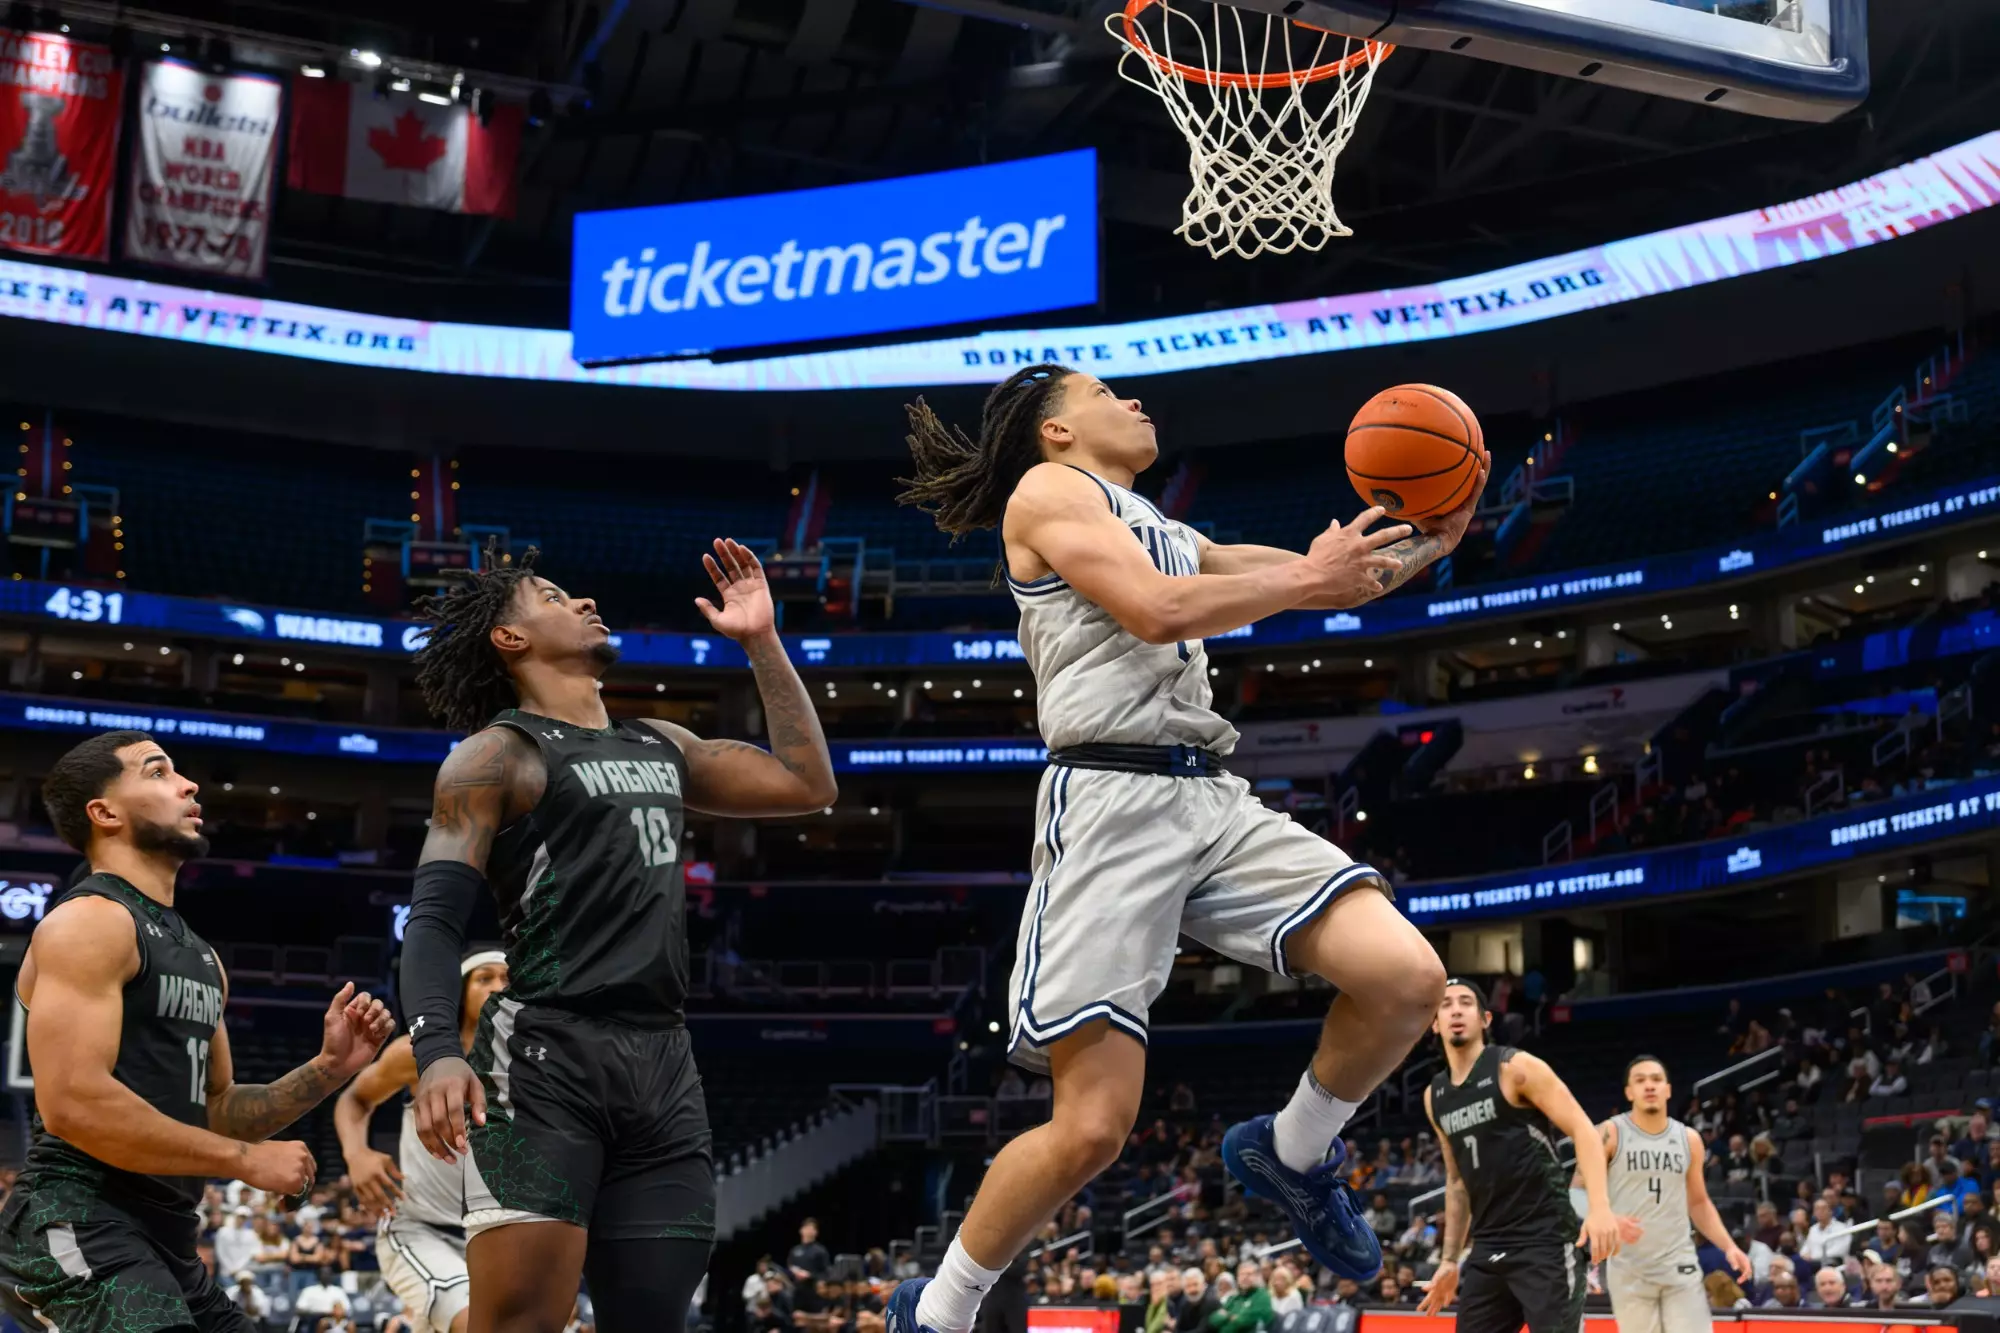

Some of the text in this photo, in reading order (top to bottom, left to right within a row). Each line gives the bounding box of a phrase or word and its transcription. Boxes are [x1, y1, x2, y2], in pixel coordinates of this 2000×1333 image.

[183, 136, 225, 161] NBA
[166, 162, 240, 191] WORLD
[139, 181, 264, 219] CHAMPIONS
[601, 215, 1066, 317] ticketmaster
[0, 280, 416, 352] ETS AT VETTIX.ORG
[962, 268, 1603, 366] DONATE TICKETS AT VETTIX.ORG
[1823, 517, 1876, 543] DONATE
[1945, 495, 1965, 513] AT
[45, 588, 123, 623] 4:31
[1540, 583, 1560, 599] AT
[275, 613, 382, 646] WAGNER
[954, 641, 992, 660] 1:49
[570, 760, 682, 798] WAGNER
[630, 807, 677, 867] 10
[1830, 817, 1887, 846] DONATE
[1890, 802, 1954, 832] TICKETS
[1958, 796, 1980, 818] AT
[1409, 893, 1471, 913] DONATE
[1474, 884, 1531, 907] TICKETS
[1534, 880, 1555, 898] AT
[157, 974, 222, 1029] WAGNE
[1440, 1097, 1497, 1136] WAGNER
[1463, 1135, 1480, 1169] 7
[1626, 1150, 1685, 1175] HOYAS
[1648, 1177, 1662, 1204] 4
